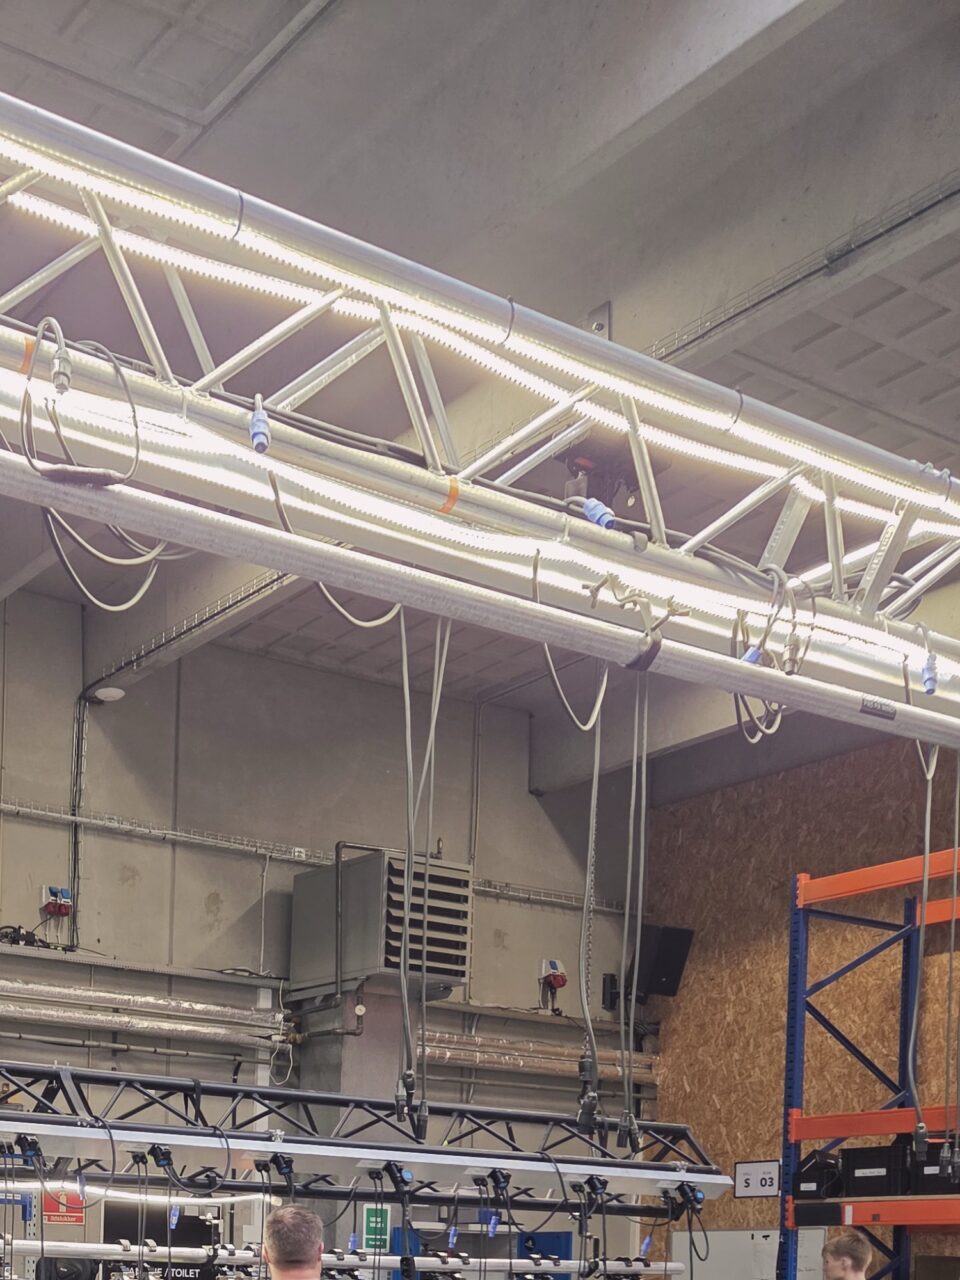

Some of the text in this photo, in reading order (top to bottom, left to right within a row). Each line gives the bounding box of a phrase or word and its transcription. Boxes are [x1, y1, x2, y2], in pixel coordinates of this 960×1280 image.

[744, 1177, 774, 1188] S 03
[171, 1268, 200, 1278] TOILET
